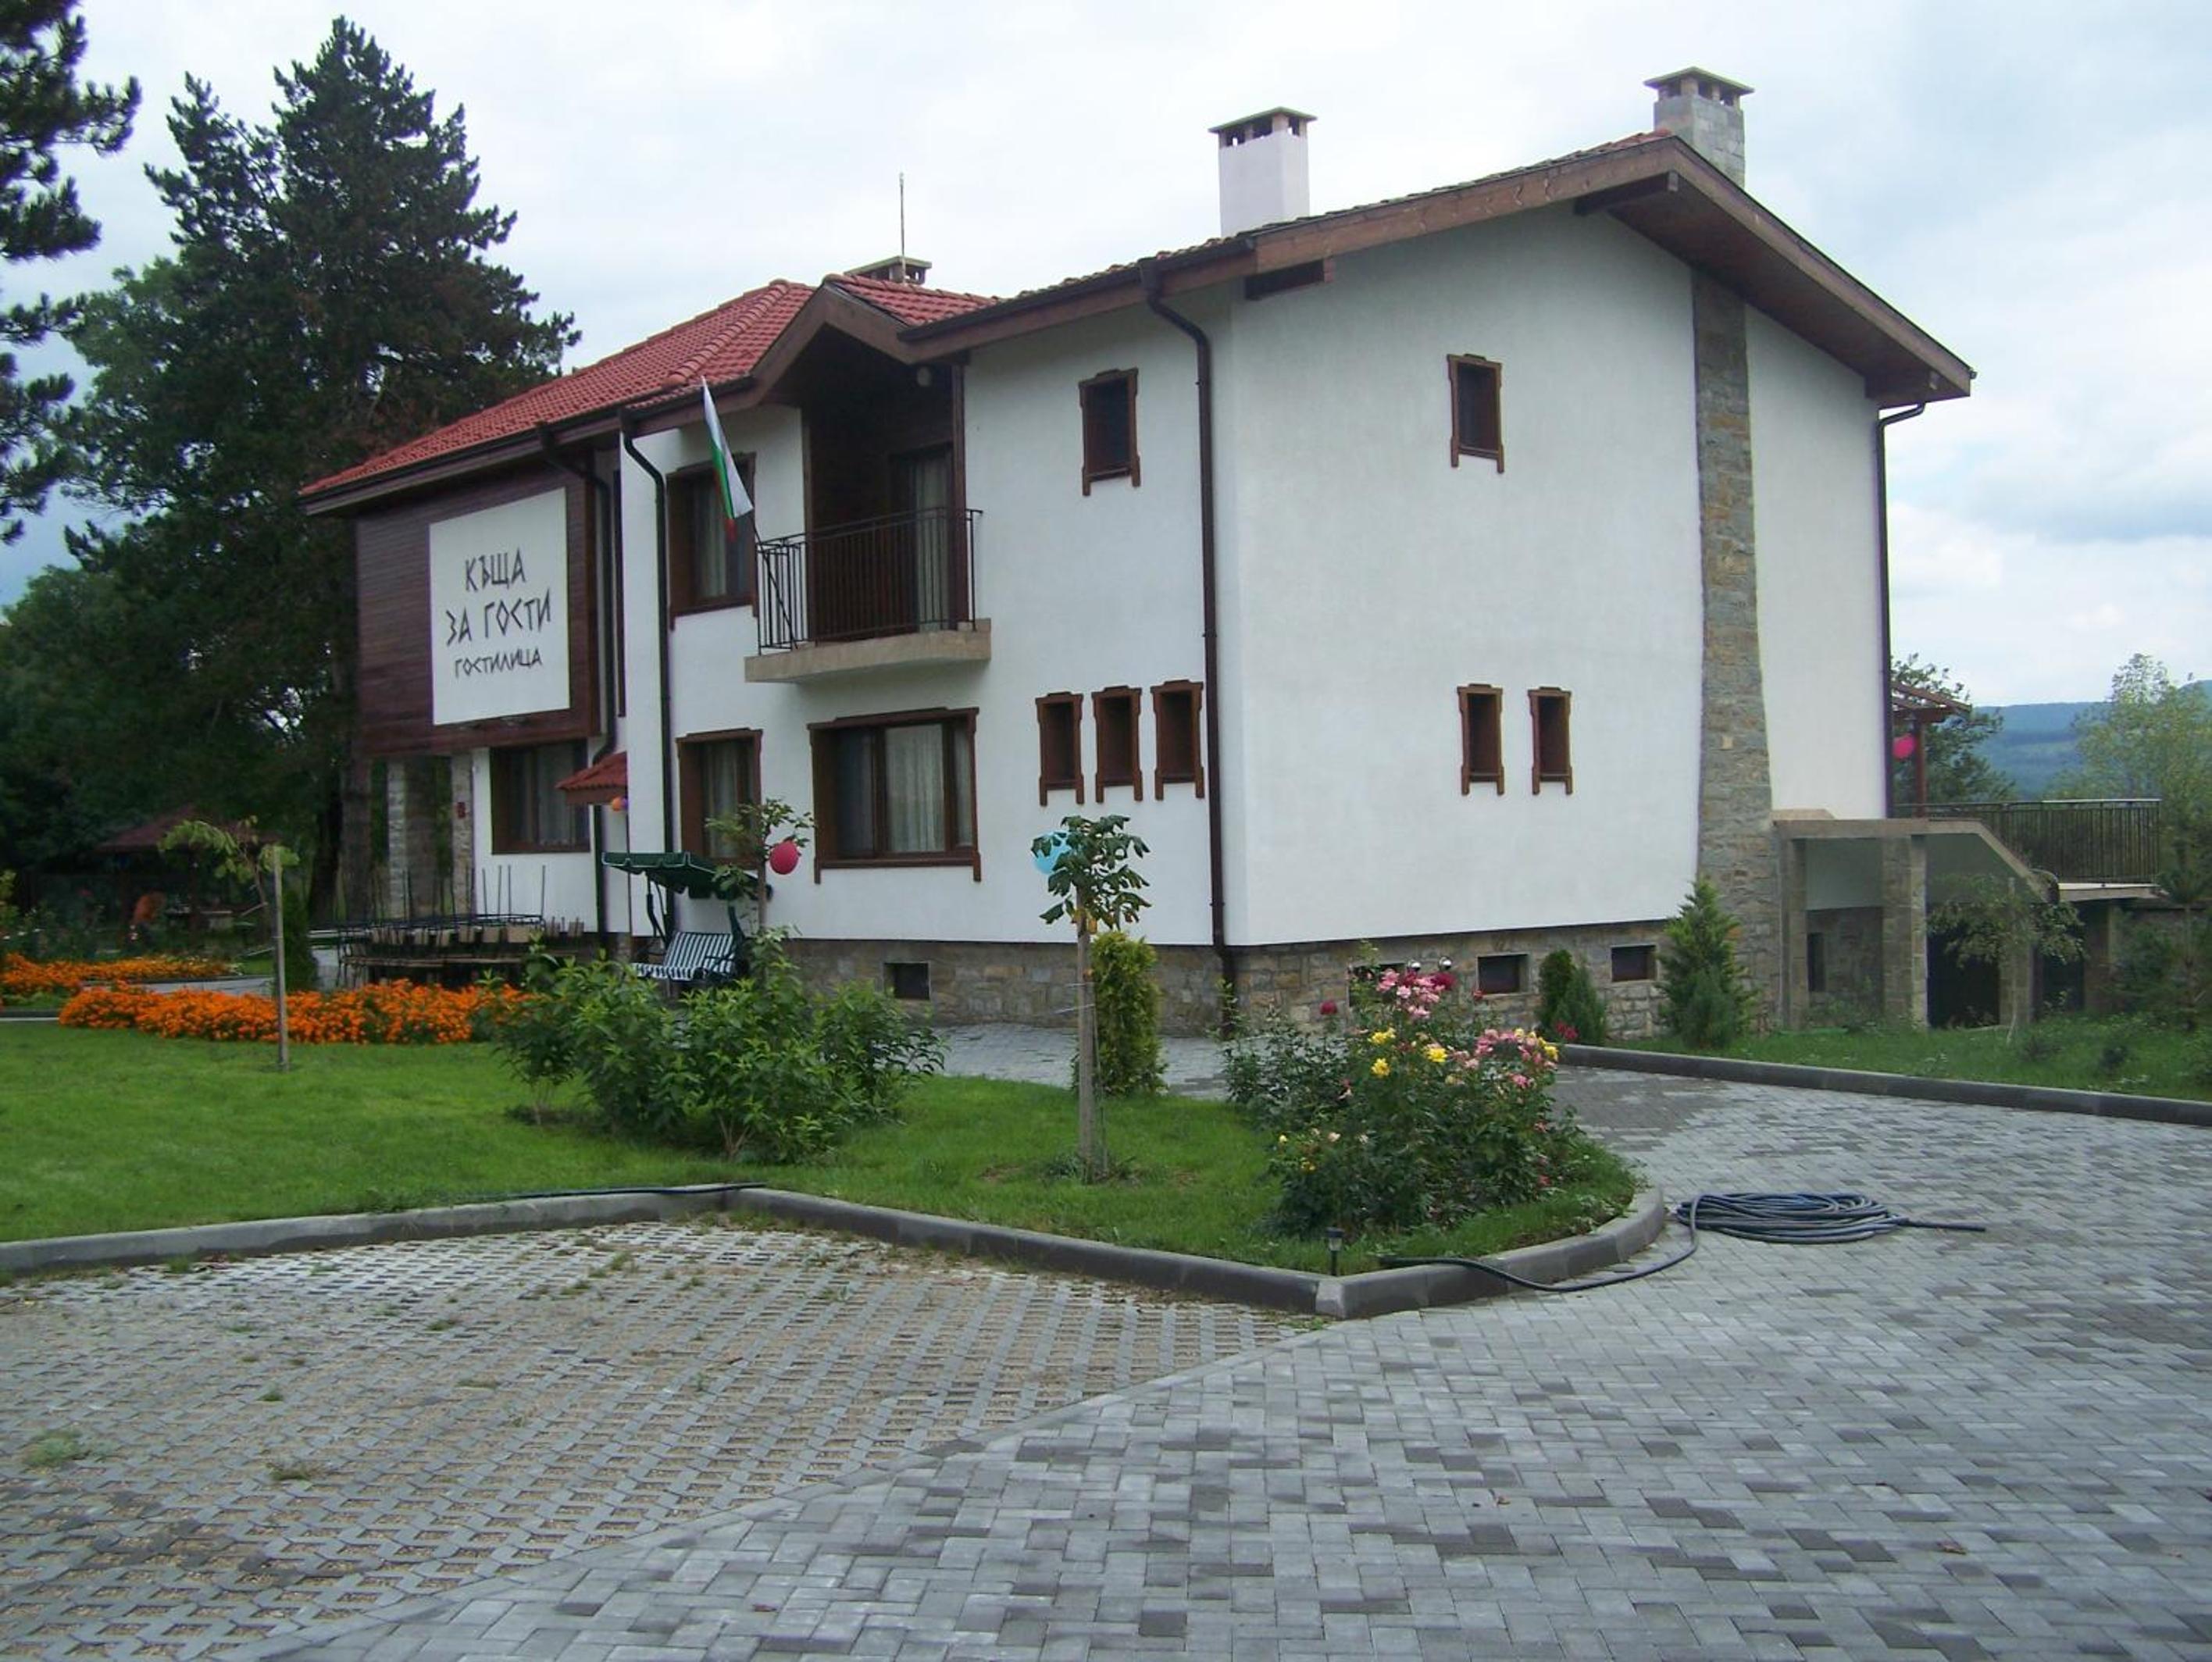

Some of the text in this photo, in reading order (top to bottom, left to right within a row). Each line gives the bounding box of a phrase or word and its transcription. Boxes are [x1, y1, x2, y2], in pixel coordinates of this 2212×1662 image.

[466, 548, 526, 591] КЪЩА
[446, 589, 551, 646] ЗА ГОСТИ
[455, 647, 542, 678] ГОСТИЛИЦА
